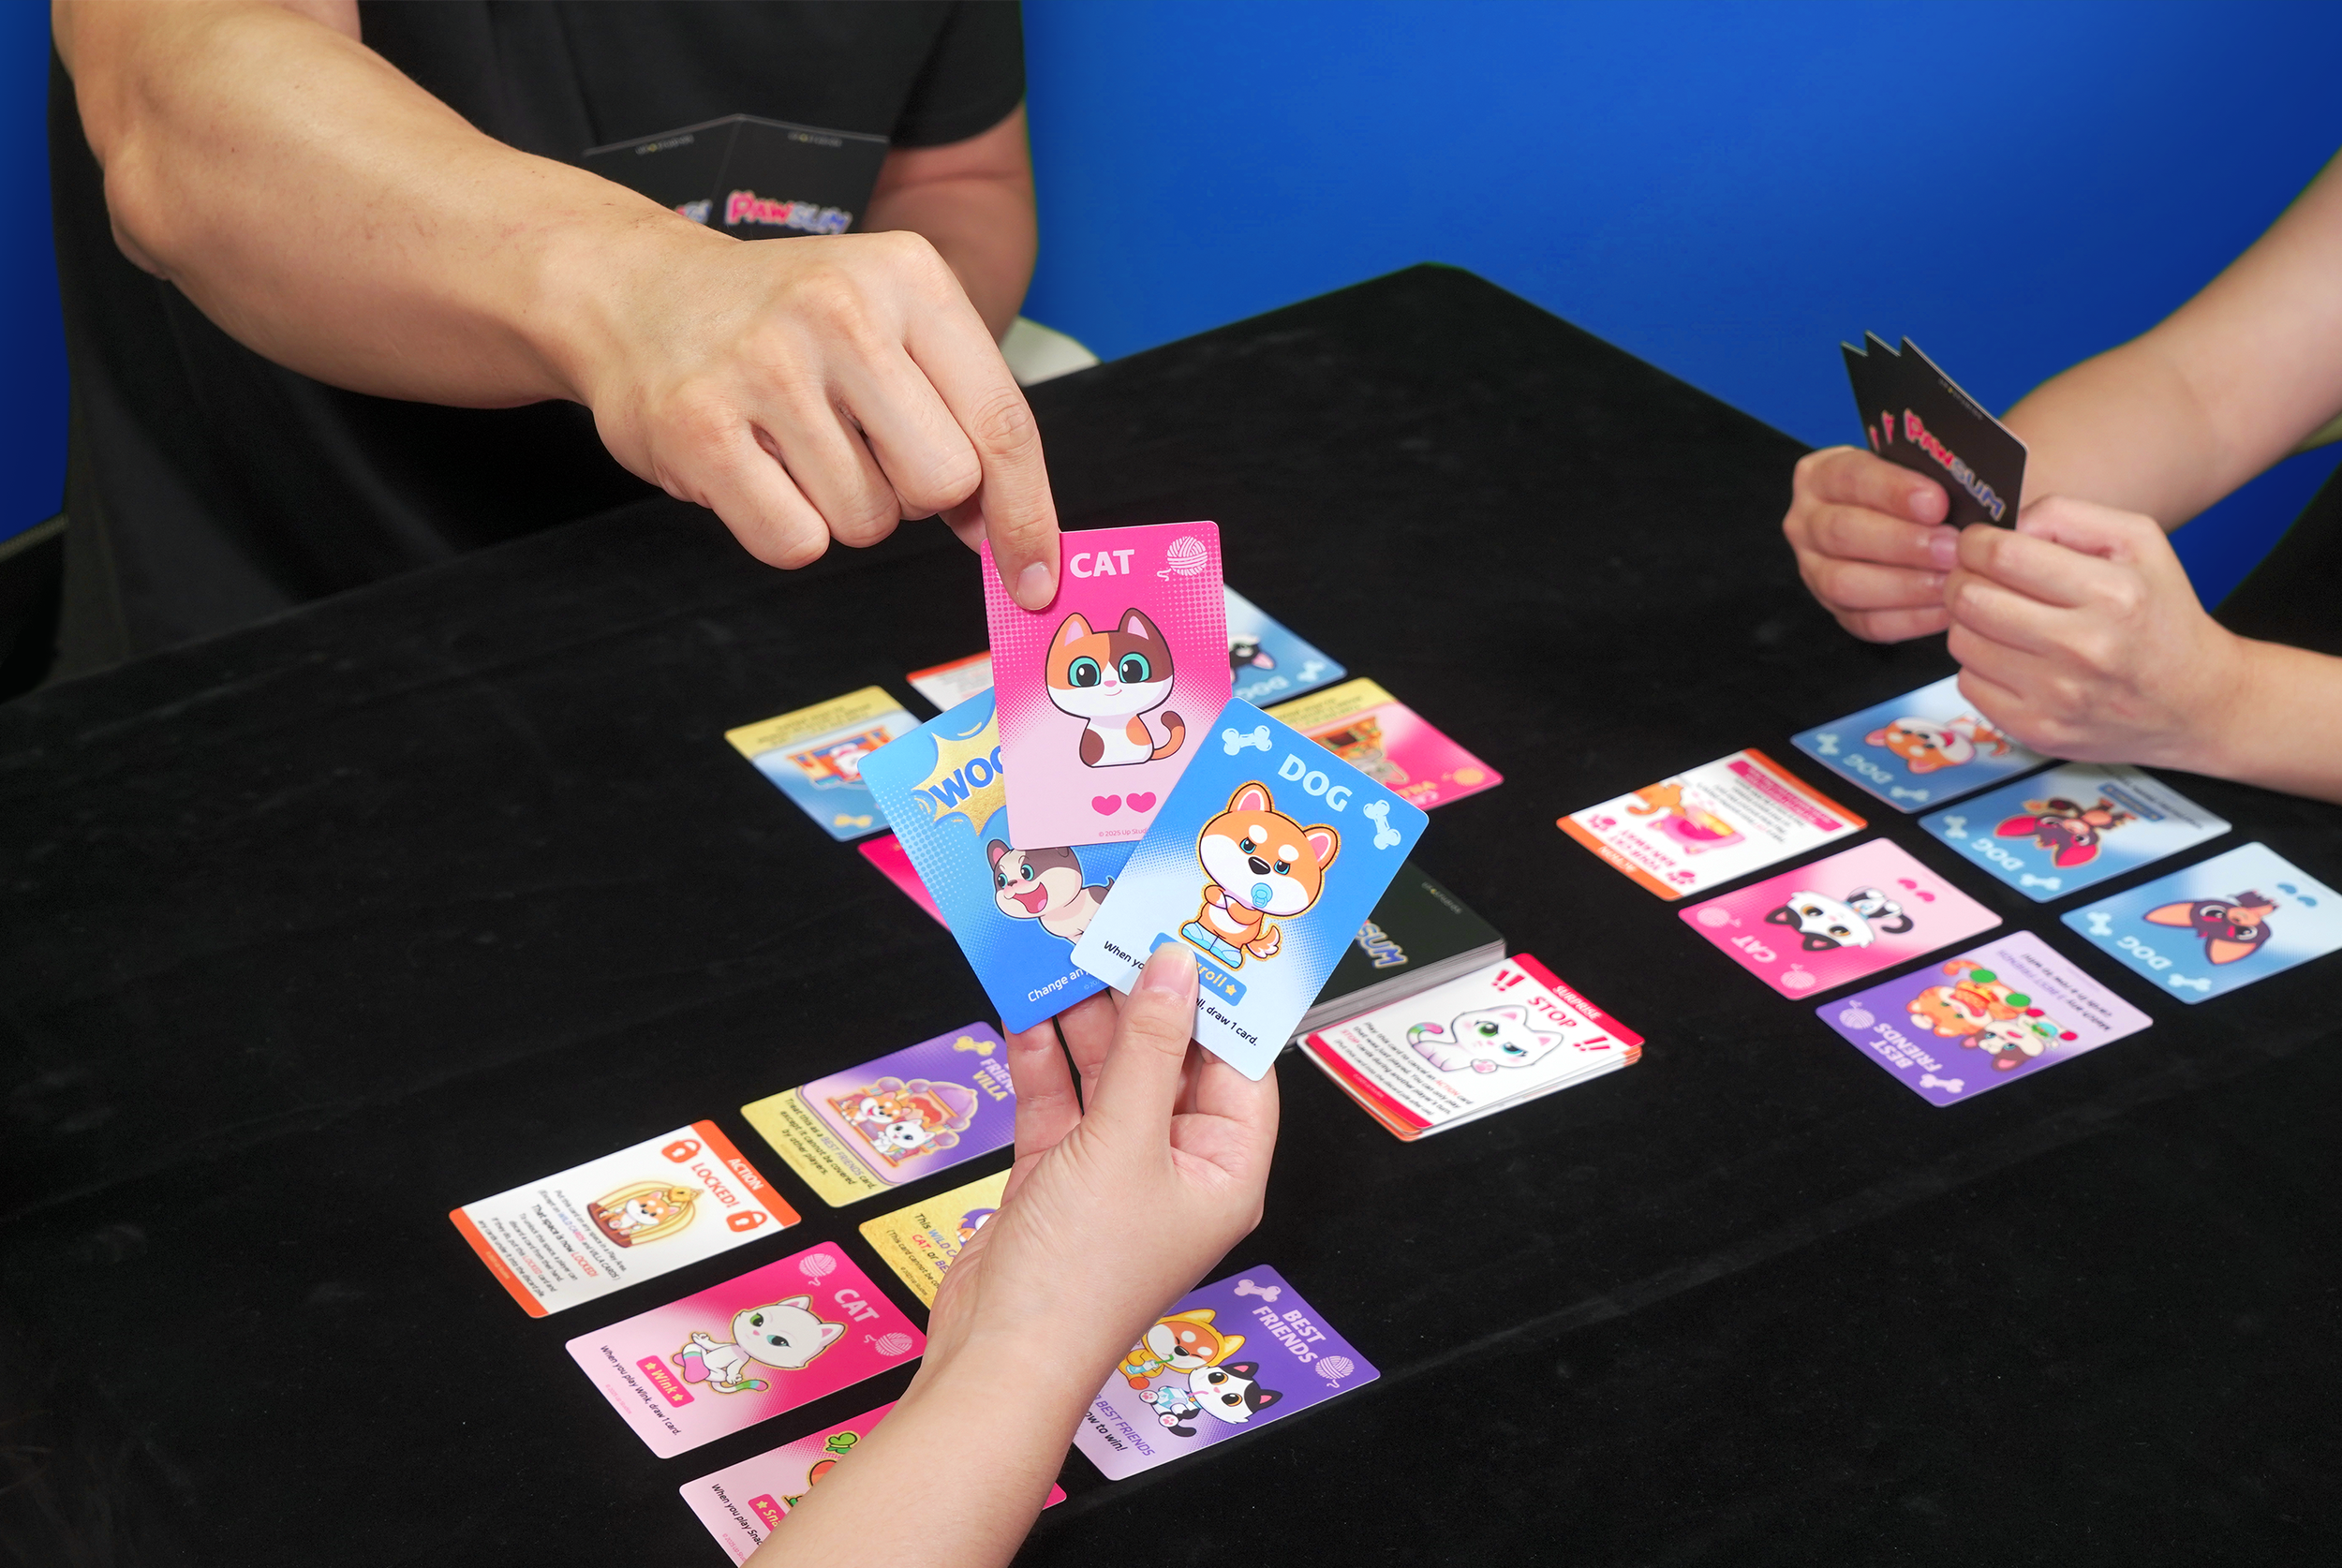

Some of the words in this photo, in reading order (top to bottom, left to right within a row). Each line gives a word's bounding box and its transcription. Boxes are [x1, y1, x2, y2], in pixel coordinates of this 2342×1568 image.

[724, 190, 852, 234] PAWSUM
[1903, 407, 2006, 521] PAWSUM
[1070, 550, 1134, 578] CAT
[928, 746, 1003, 809] WOO
[1278, 753, 1353, 812] DOG
[1838, 752, 1898, 785] DOG
[1967, 836, 2027, 872] DOG
[1104, 940, 1131, 961] When
[1133, 958, 1144, 971] yo
[1357, 919, 1409, 969] SUM
[1728, 931, 1782, 965] CAT
[2112, 934, 2174, 971] DOG
[1028, 976, 1069, 1002] Change
[1069, 969, 1089, 981] an
[1549, 984, 1605, 1020] SURPRISE
[1207, 1003, 1230, 1025] draw
[1231, 1022, 1238, 1030] 1
[1236, 1027, 1258, 1046] card.
[1524, 995, 1580, 1029] STOP
[1360, 1021, 1381, 1033] Play
[1374, 1032, 1392, 1043] this
[1385, 1042, 1405, 1054] card
[1406, 1058, 1430, 1074] cancel
[1433, 1078, 1460, 1096] ACTION
[1456, 1094, 1474, 1104] card
[1868, 1037, 1916, 1069] BEST
[1871, 1021, 1944, 1072] FRIENDS
[969, 1069, 1011, 1102] VILLA
[981, 1058, 1016, 1098] FRIEN
[778, 1110, 801, 1131] except
[803, 1134, 826, 1155] cannot
[822, 1154, 835, 1163] be
[830, 1161, 856, 1185] covered
[779, 1128, 793, 1137] by
[789, 1136, 808, 1153] other
[803, 1152, 829, 1175] players.
[783, 1098, 804, 1114] Treat
[798, 1114, 814, 1126] this
[808, 1125, 821, 1133] as
[820, 1135, 840, 1152] BEST
[834, 1150, 864, 1176] FRIENDS
[857, 1174, 877, 1189] card,
[689, 1161, 740, 1208] LOCKED!
[726, 1156, 765, 1191] ACTION
[493, 1220, 508, 1233] they
[501, 1231, 513, 1239] do,
[507, 1238, 520, 1247] put
[529, 1204, 548, 1219] That
[540, 1218, 560, 1235] space
[559, 1238, 575, 1252] now
[570, 1250, 599, 1278] LOCKED!
[553, 1189, 565, 1198] Put
[560, 1198, 572, 1207] this
[567, 1206, 581, 1217] card
[580, 1222, 593, 1232] any
[587, 1231, 603, 1244] space
[605, 1250, 618, 1261] Play
[614, 1259, 628, 1271] Area.
[912, 1213, 933, 1229] This
[926, 1228, 951, 1250] WILD
[476, 1219, 488, 1229] any
[483, 1228, 498, 1241] cards
[494, 1240, 509, 1253] under
[507, 1257, 520, 1267] into
[514, 1265, 526, 1274] the
[521, 1273, 539, 1289] discard
[533, 1287, 546, 1297] pile.
[508, 1220, 526, 1236] discard
[523, 1238, 536, 1249] card
[531, 1248, 545, 1260] from
[540, 1259, 554, 1270] their
[548, 1269, 563, 1281] hand.
[513, 1246, 526, 1256] this
[521, 1254, 542, 1275] LOCKED
[522, 1219, 540, 1235] unlock
[534, 1233, 547, 1243] this
[541, 1242, 558, 1256] space,
[555, 1258, 571, 1273] player
[567, 1272, 578, 1280] can
[885, 1229, 903, 1243] (This
[897, 1242, 913, 1255] card
[908, 1254, 929, 1274] cannot
[910, 1234, 932, 1251] CAT,
[926, 1251, 939, 1260] or
[537, 1274, 550, 1284] card
[544, 1283, 556, 1293] and
[830, 1285, 880, 1325] CAT
[1250, 1305, 1319, 1365] FRIENDS
[1281, 1309, 1327, 1345] BEST
[599, 1345, 620, 1363] When
[612, 1363, 628, 1375] you
[621, 1373, 640, 1388] play
[632, 1386, 654, 1404] Wink,
[647, 1402, 666, 1418] draw
[663, 1420, 682, 1436] card.
[649, 1368, 679, 1394] Wink
[1082, 1411, 1100, 1425] ow
[1094, 1423, 1110, 1434] to
[1104, 1432, 1128, 1452] win!
[1094, 1399, 1122, 1422] BEST
[1114, 1420, 1155, 1457] FRIENDS
[708, 1483, 733, 1503] When
[723, 1503, 741, 1516] you
[734, 1515, 753, 1531] play
[746, 1528, 765, 1545] Snac
[762, 1508, 785, 1527] Sna
